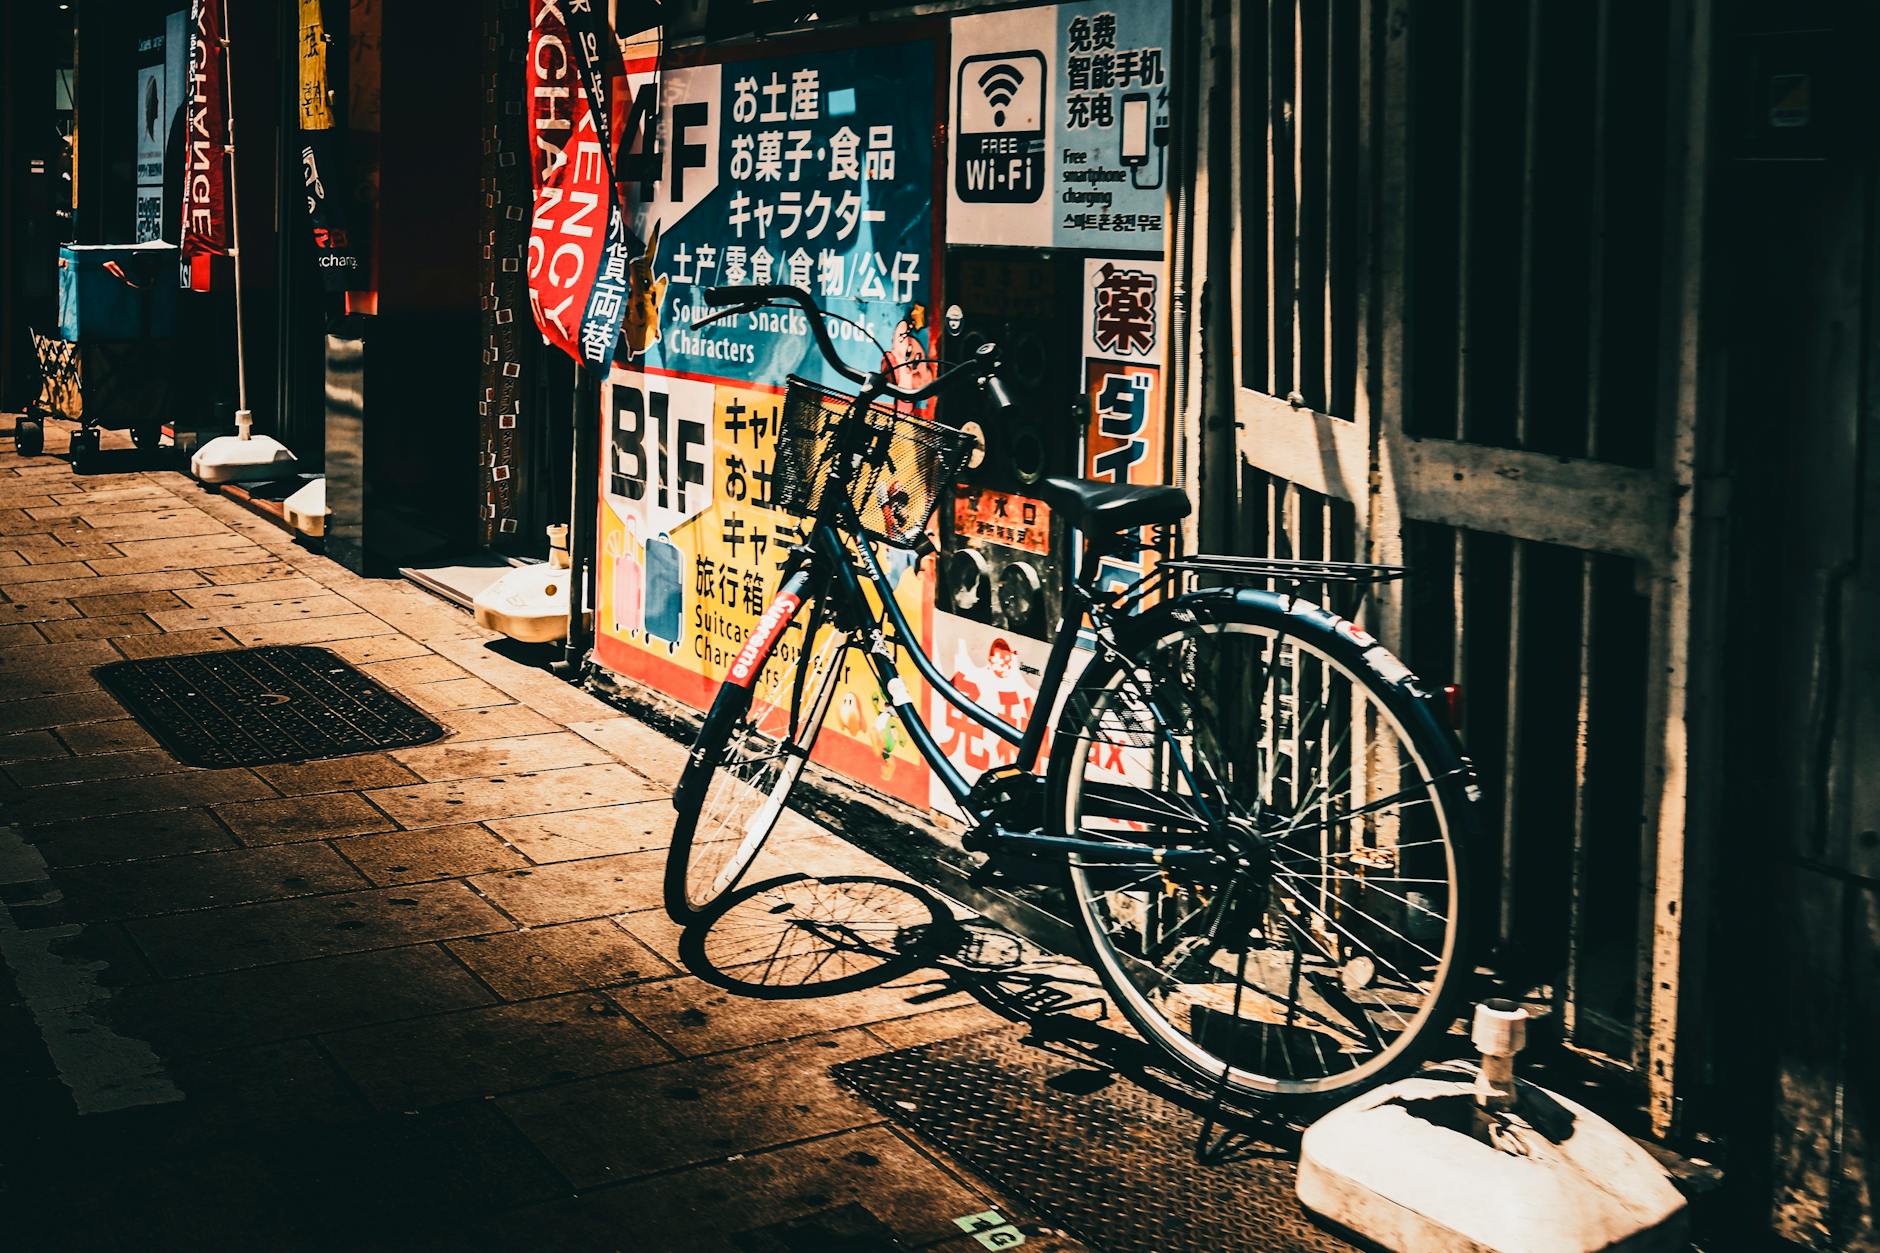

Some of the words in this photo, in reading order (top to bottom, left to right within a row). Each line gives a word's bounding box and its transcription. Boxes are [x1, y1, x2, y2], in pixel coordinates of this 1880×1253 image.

[1068, 13, 1116, 53] 免费
[1067, 49, 1165, 91] 智能手机
[733, 68, 820, 124] お土産
[1066, 92, 1114, 130] 充电
[616, 82, 709, 203] 4F
[730, 125, 896, 183] お菓子・食品
[980, 138, 1018, 154] FREE
[1063, 148, 1088, 165] Free
[1062, 167, 1127, 187] smartphone
[1062, 187, 1113, 208] charging
[728, 189, 887, 242] キャラクター
[582, 205, 629, 363] 外貨両替
[749, 307, 808, 337] Snacks
[827, 313, 875, 344] oods
[1092, 262, 1157, 355] 薬
[671, 328, 755, 364] Characters
[610, 383, 706, 514] B1F
[695, 553, 764, 617] 旅行箱
